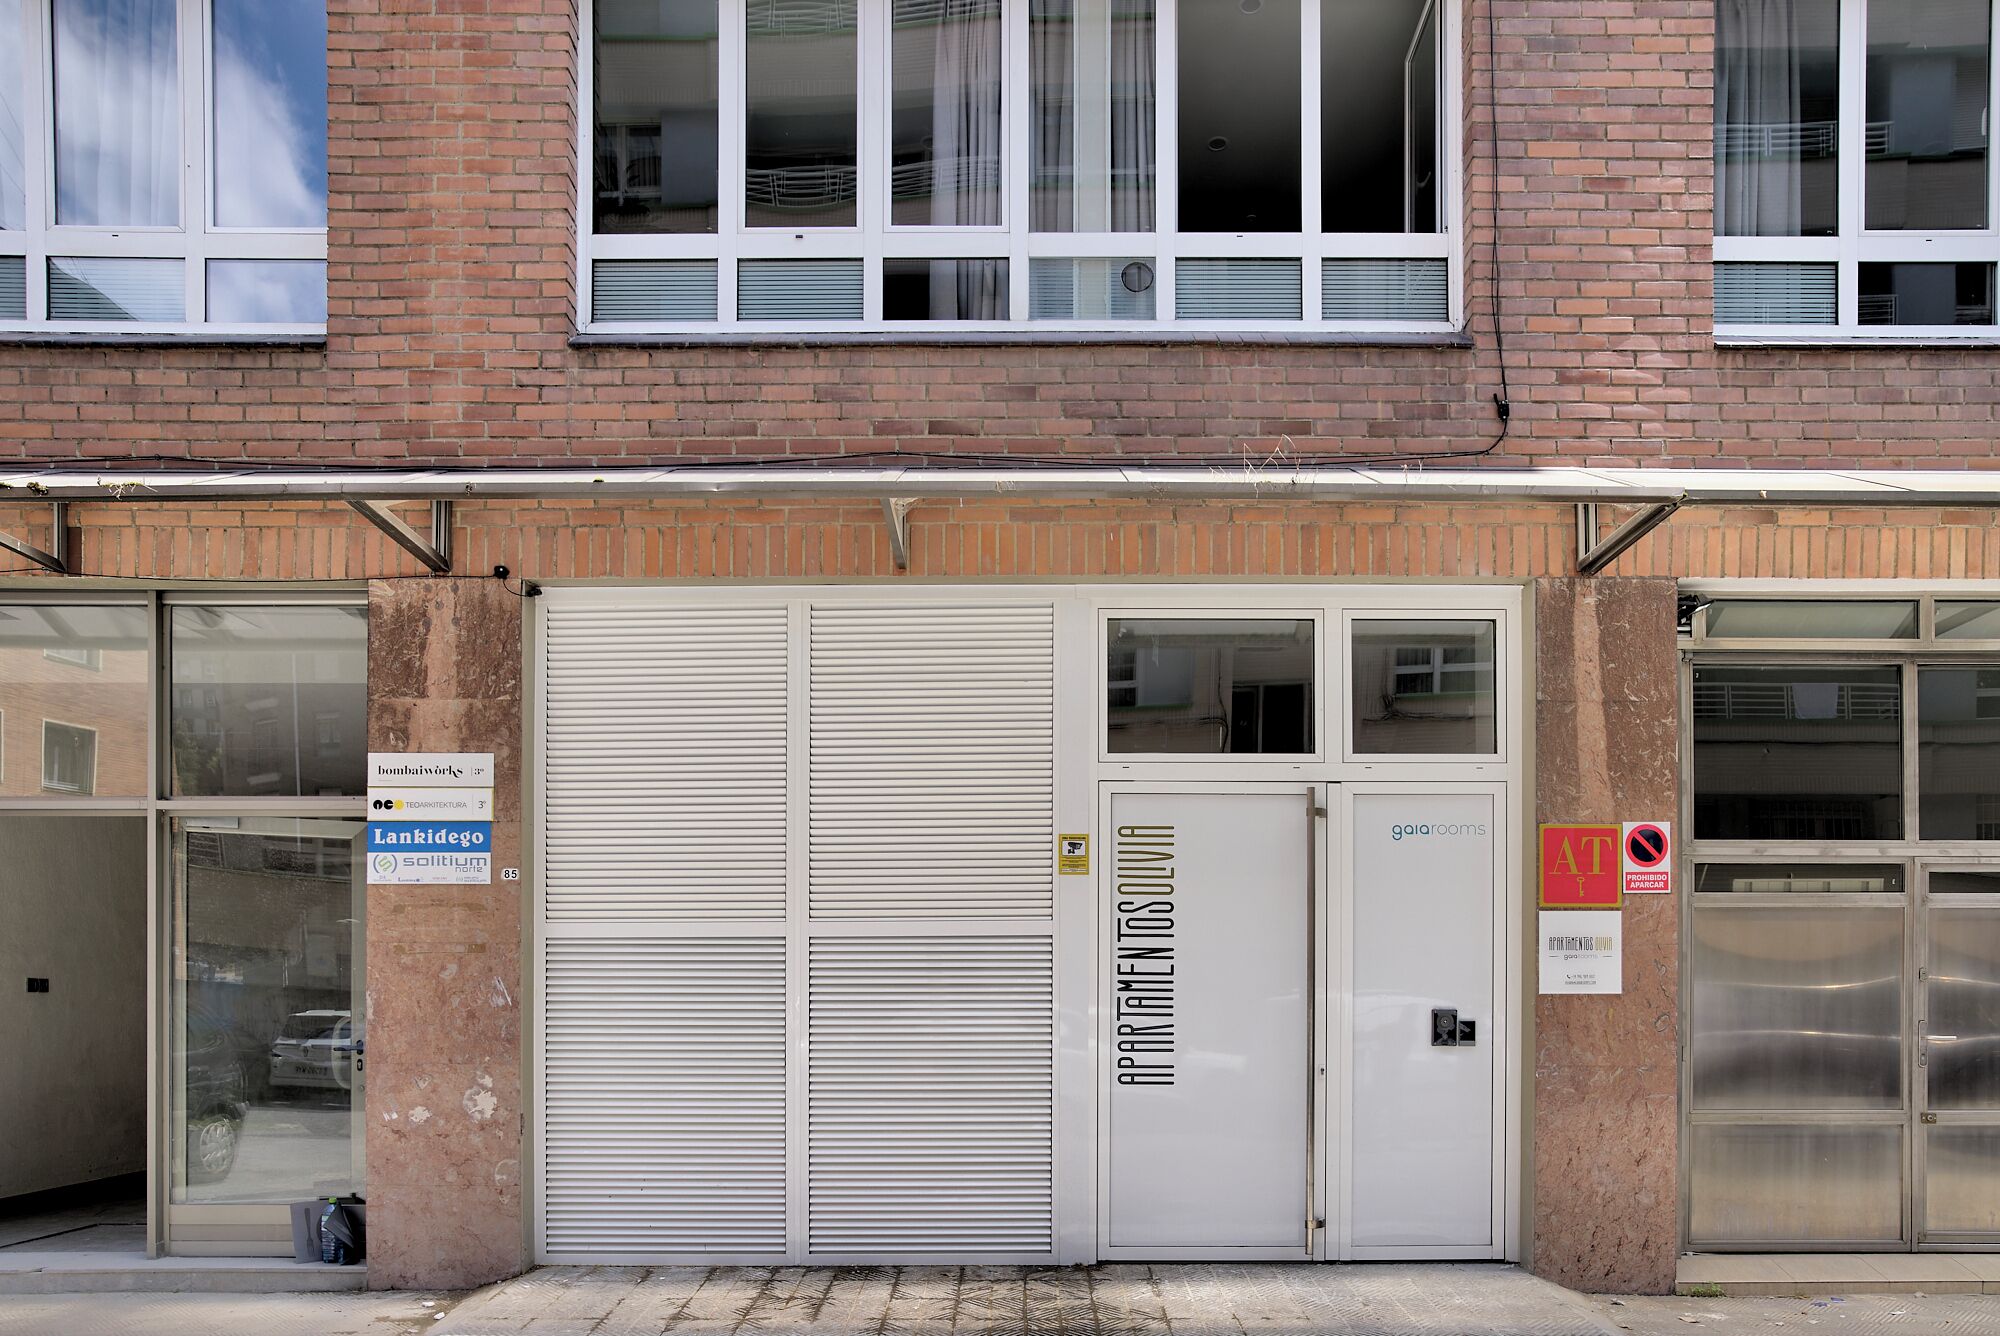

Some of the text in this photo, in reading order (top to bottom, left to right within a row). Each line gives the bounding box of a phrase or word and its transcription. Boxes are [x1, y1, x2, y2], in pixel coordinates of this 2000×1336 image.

[406, 801, 467, 809] TEOARKITEKTURA
[374, 828, 484, 847] Lankidego
[1392, 824, 1486, 841] gaiarooms
[403, 855, 487, 867] solitium
[1549, 836, 1613, 875] AT
[504, 869, 517, 879] 85
[1548, 936, 1594, 951] APARTAMENTOS
[1117, 825, 1175, 1086] APARTAMENTOS OLIVIA
